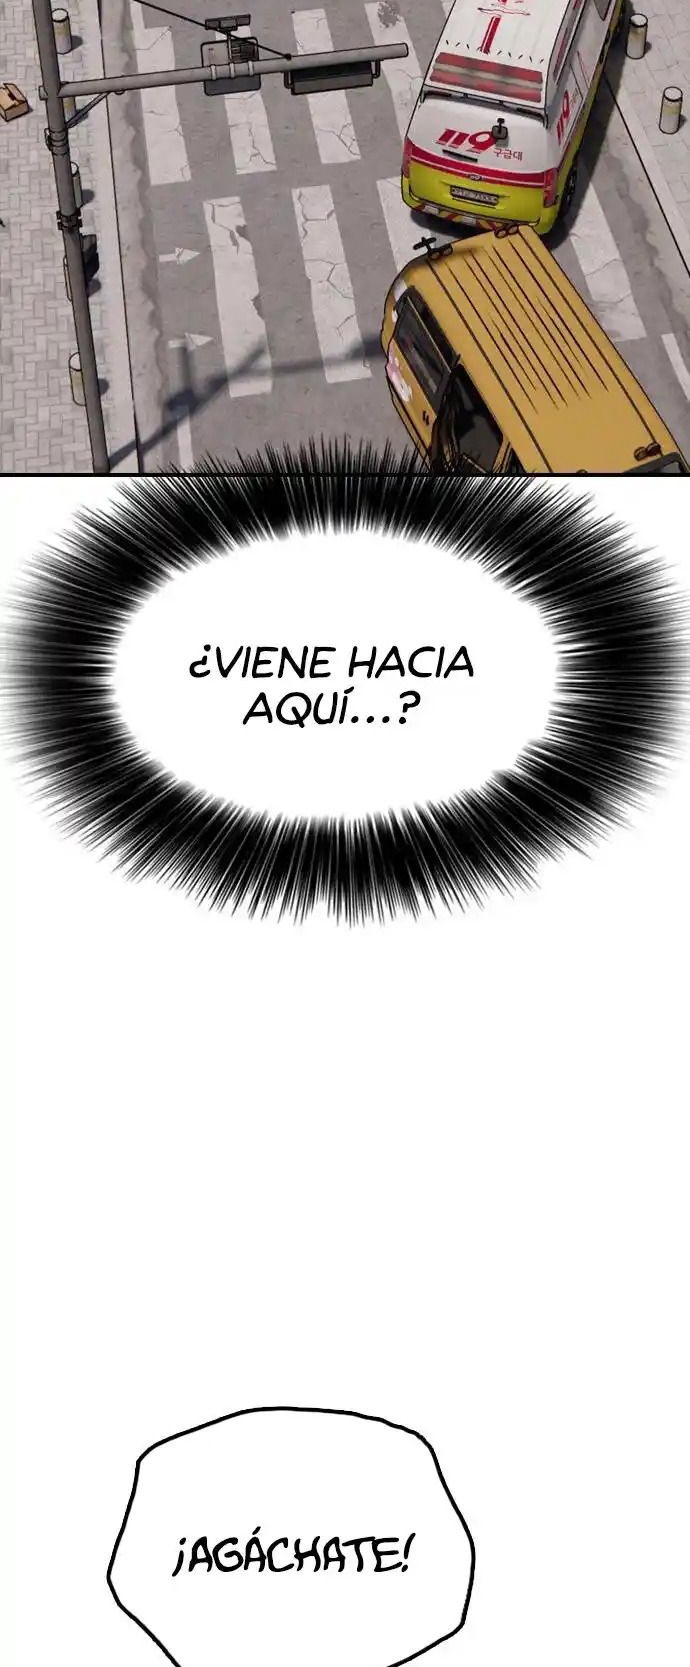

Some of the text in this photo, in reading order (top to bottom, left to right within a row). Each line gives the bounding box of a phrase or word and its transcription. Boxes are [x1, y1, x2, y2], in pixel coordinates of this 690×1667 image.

[436, 128, 497, 153] 119
[189, 644, 474, 679] ¿VIENE HACIA
[242, 686, 421, 729] AQUÍ...?
[171, 1526, 416, 1577] ¡AGÁCHATE!
